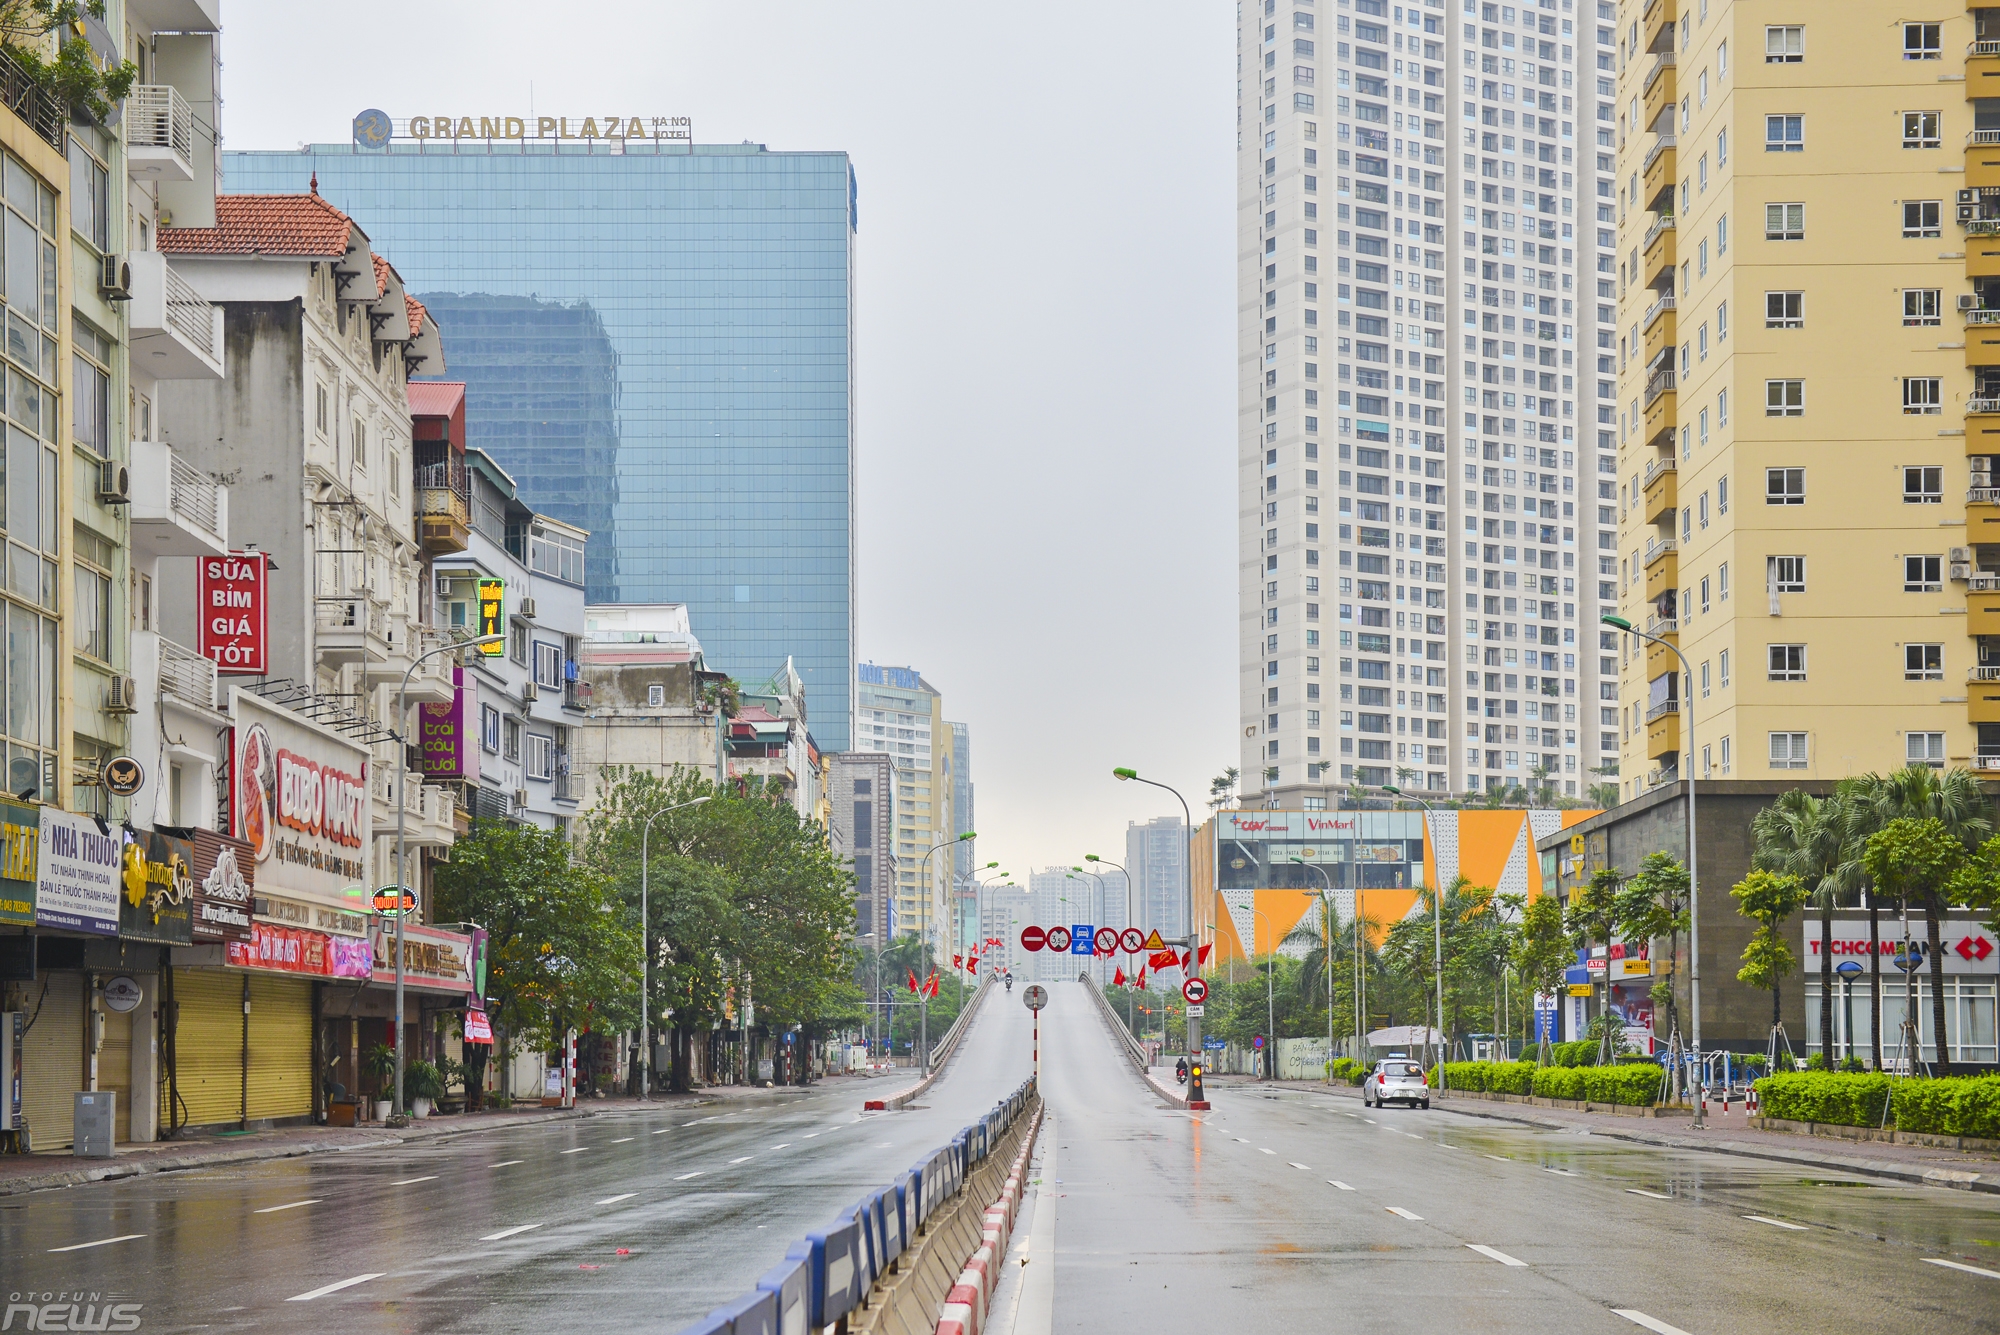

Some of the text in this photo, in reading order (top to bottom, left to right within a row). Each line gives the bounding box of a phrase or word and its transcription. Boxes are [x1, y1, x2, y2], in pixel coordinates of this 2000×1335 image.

[410, 116, 646, 139] GRAND PLAZA
[208, 558, 255, 581] SỮA
[212, 584, 252, 608] BỈM
[212, 614, 252, 636] GIÁ
[211, 638, 254, 664] TỐT
[858, 660, 920, 690] HÒA PHÁT
[425, 720, 454, 735] trái
[424, 738, 455, 755] cây
[424, 757, 456, 771] tươi
[281, 757, 364, 841] BIBO MART
[1241, 820, 1266, 831] CGV
[1308, 817, 1354, 831] VinMart
[52, 822, 118, 868] NHÀ THUỐC
[374, 896, 415, 909] HOTEL
[1810, 940, 1948, 955] TCHCOMBANK
[1588, 960, 1606, 968] ATM
